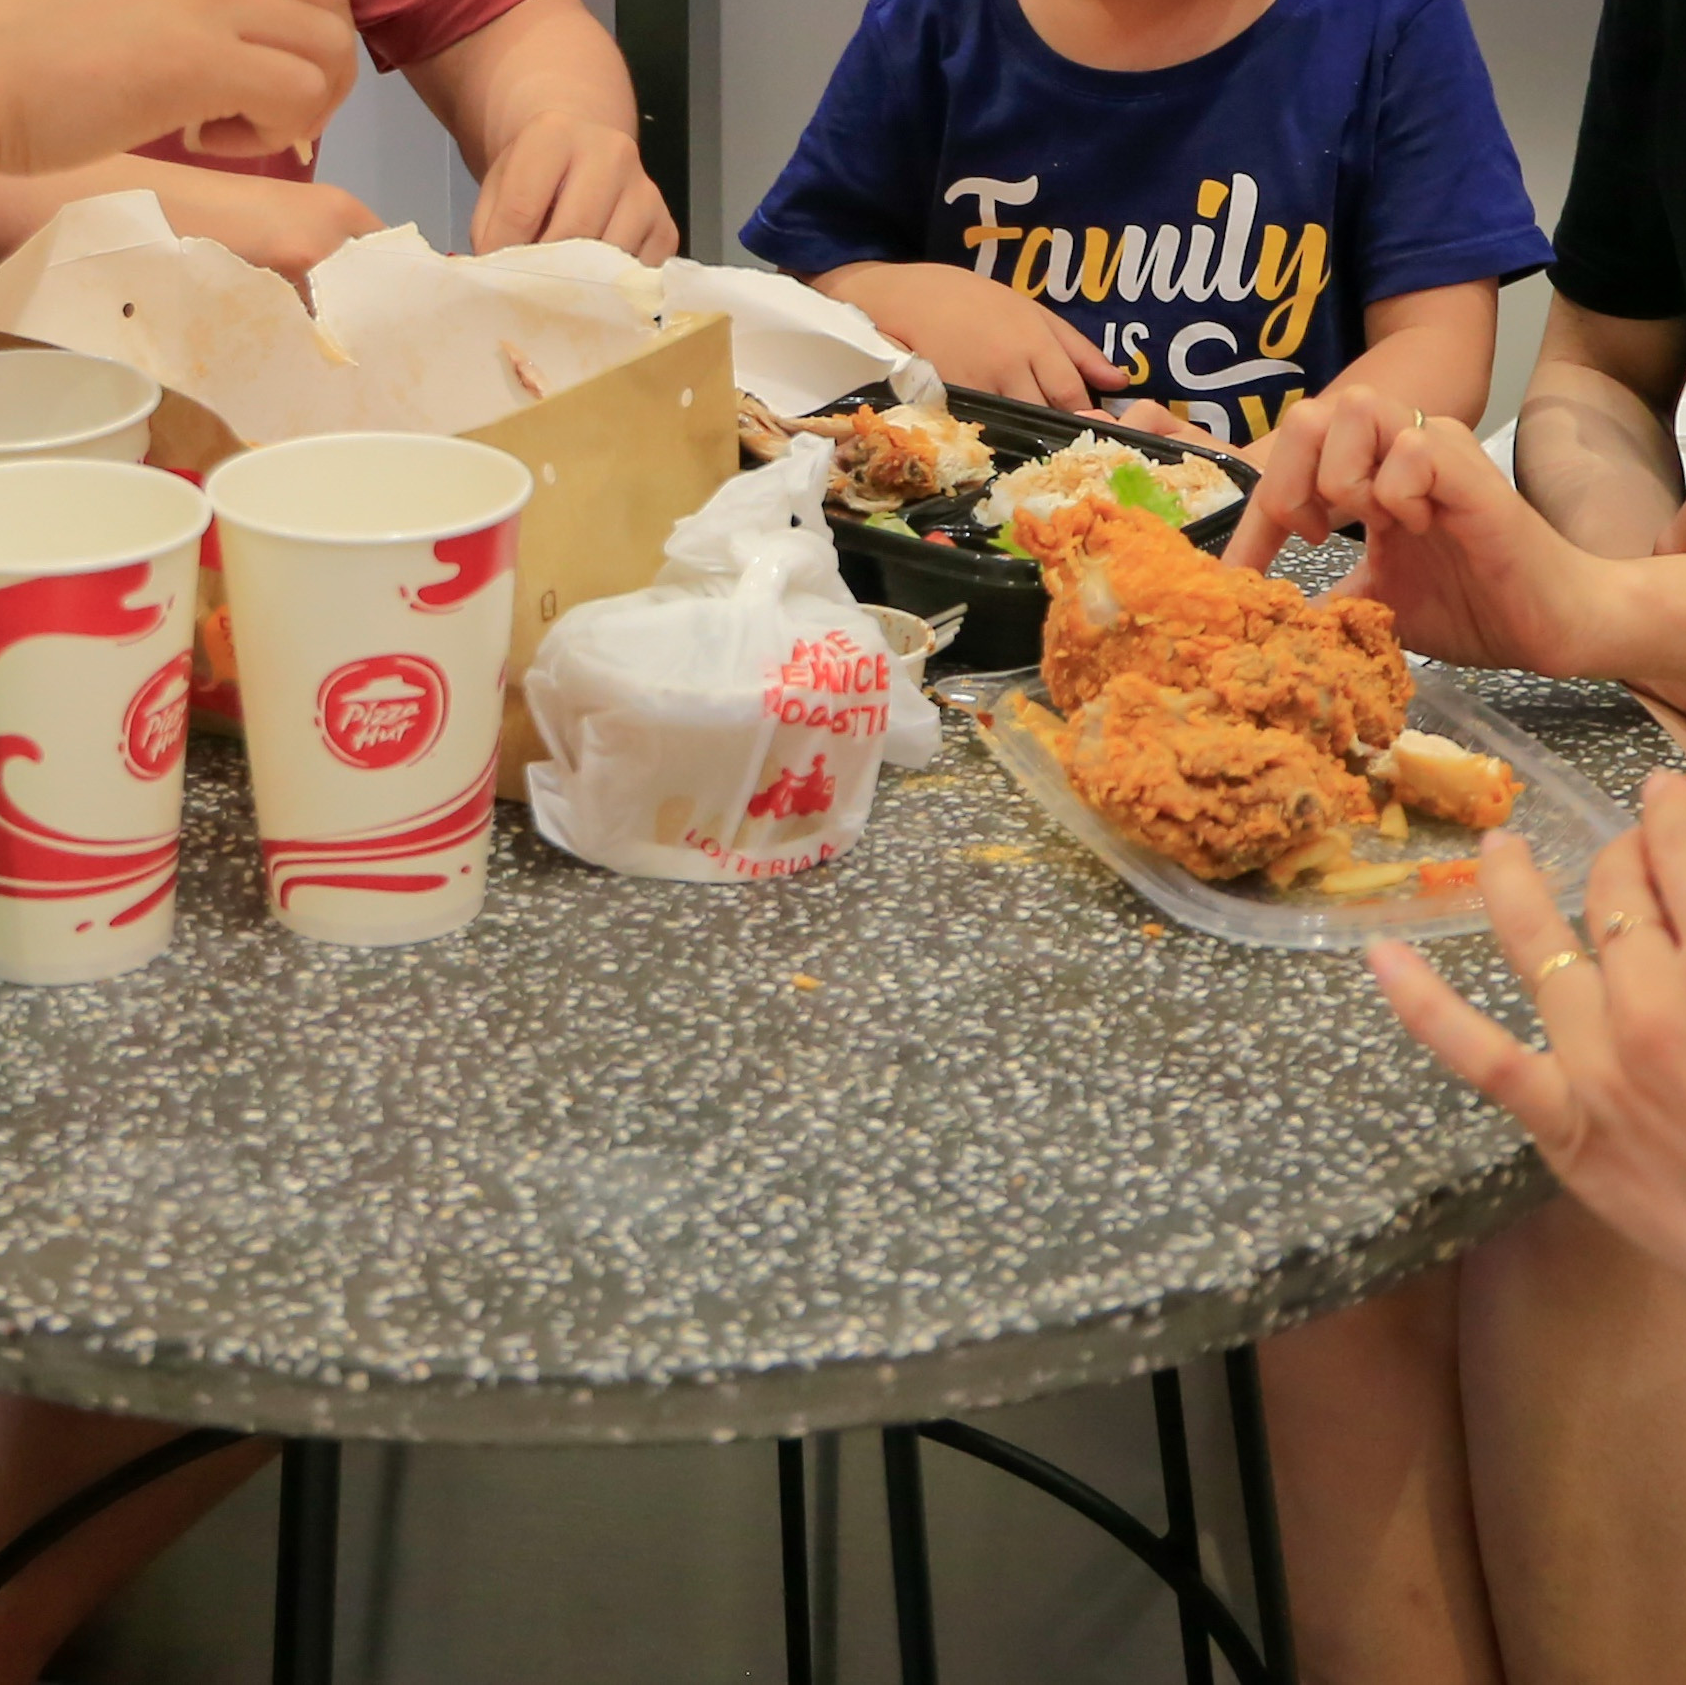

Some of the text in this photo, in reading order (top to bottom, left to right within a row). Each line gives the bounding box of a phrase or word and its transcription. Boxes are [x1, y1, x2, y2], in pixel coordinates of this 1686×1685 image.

[944, 172, 1331, 359] Family
[339, 700, 421, 734] Pizza
[351, 718, 417, 753] Hut
